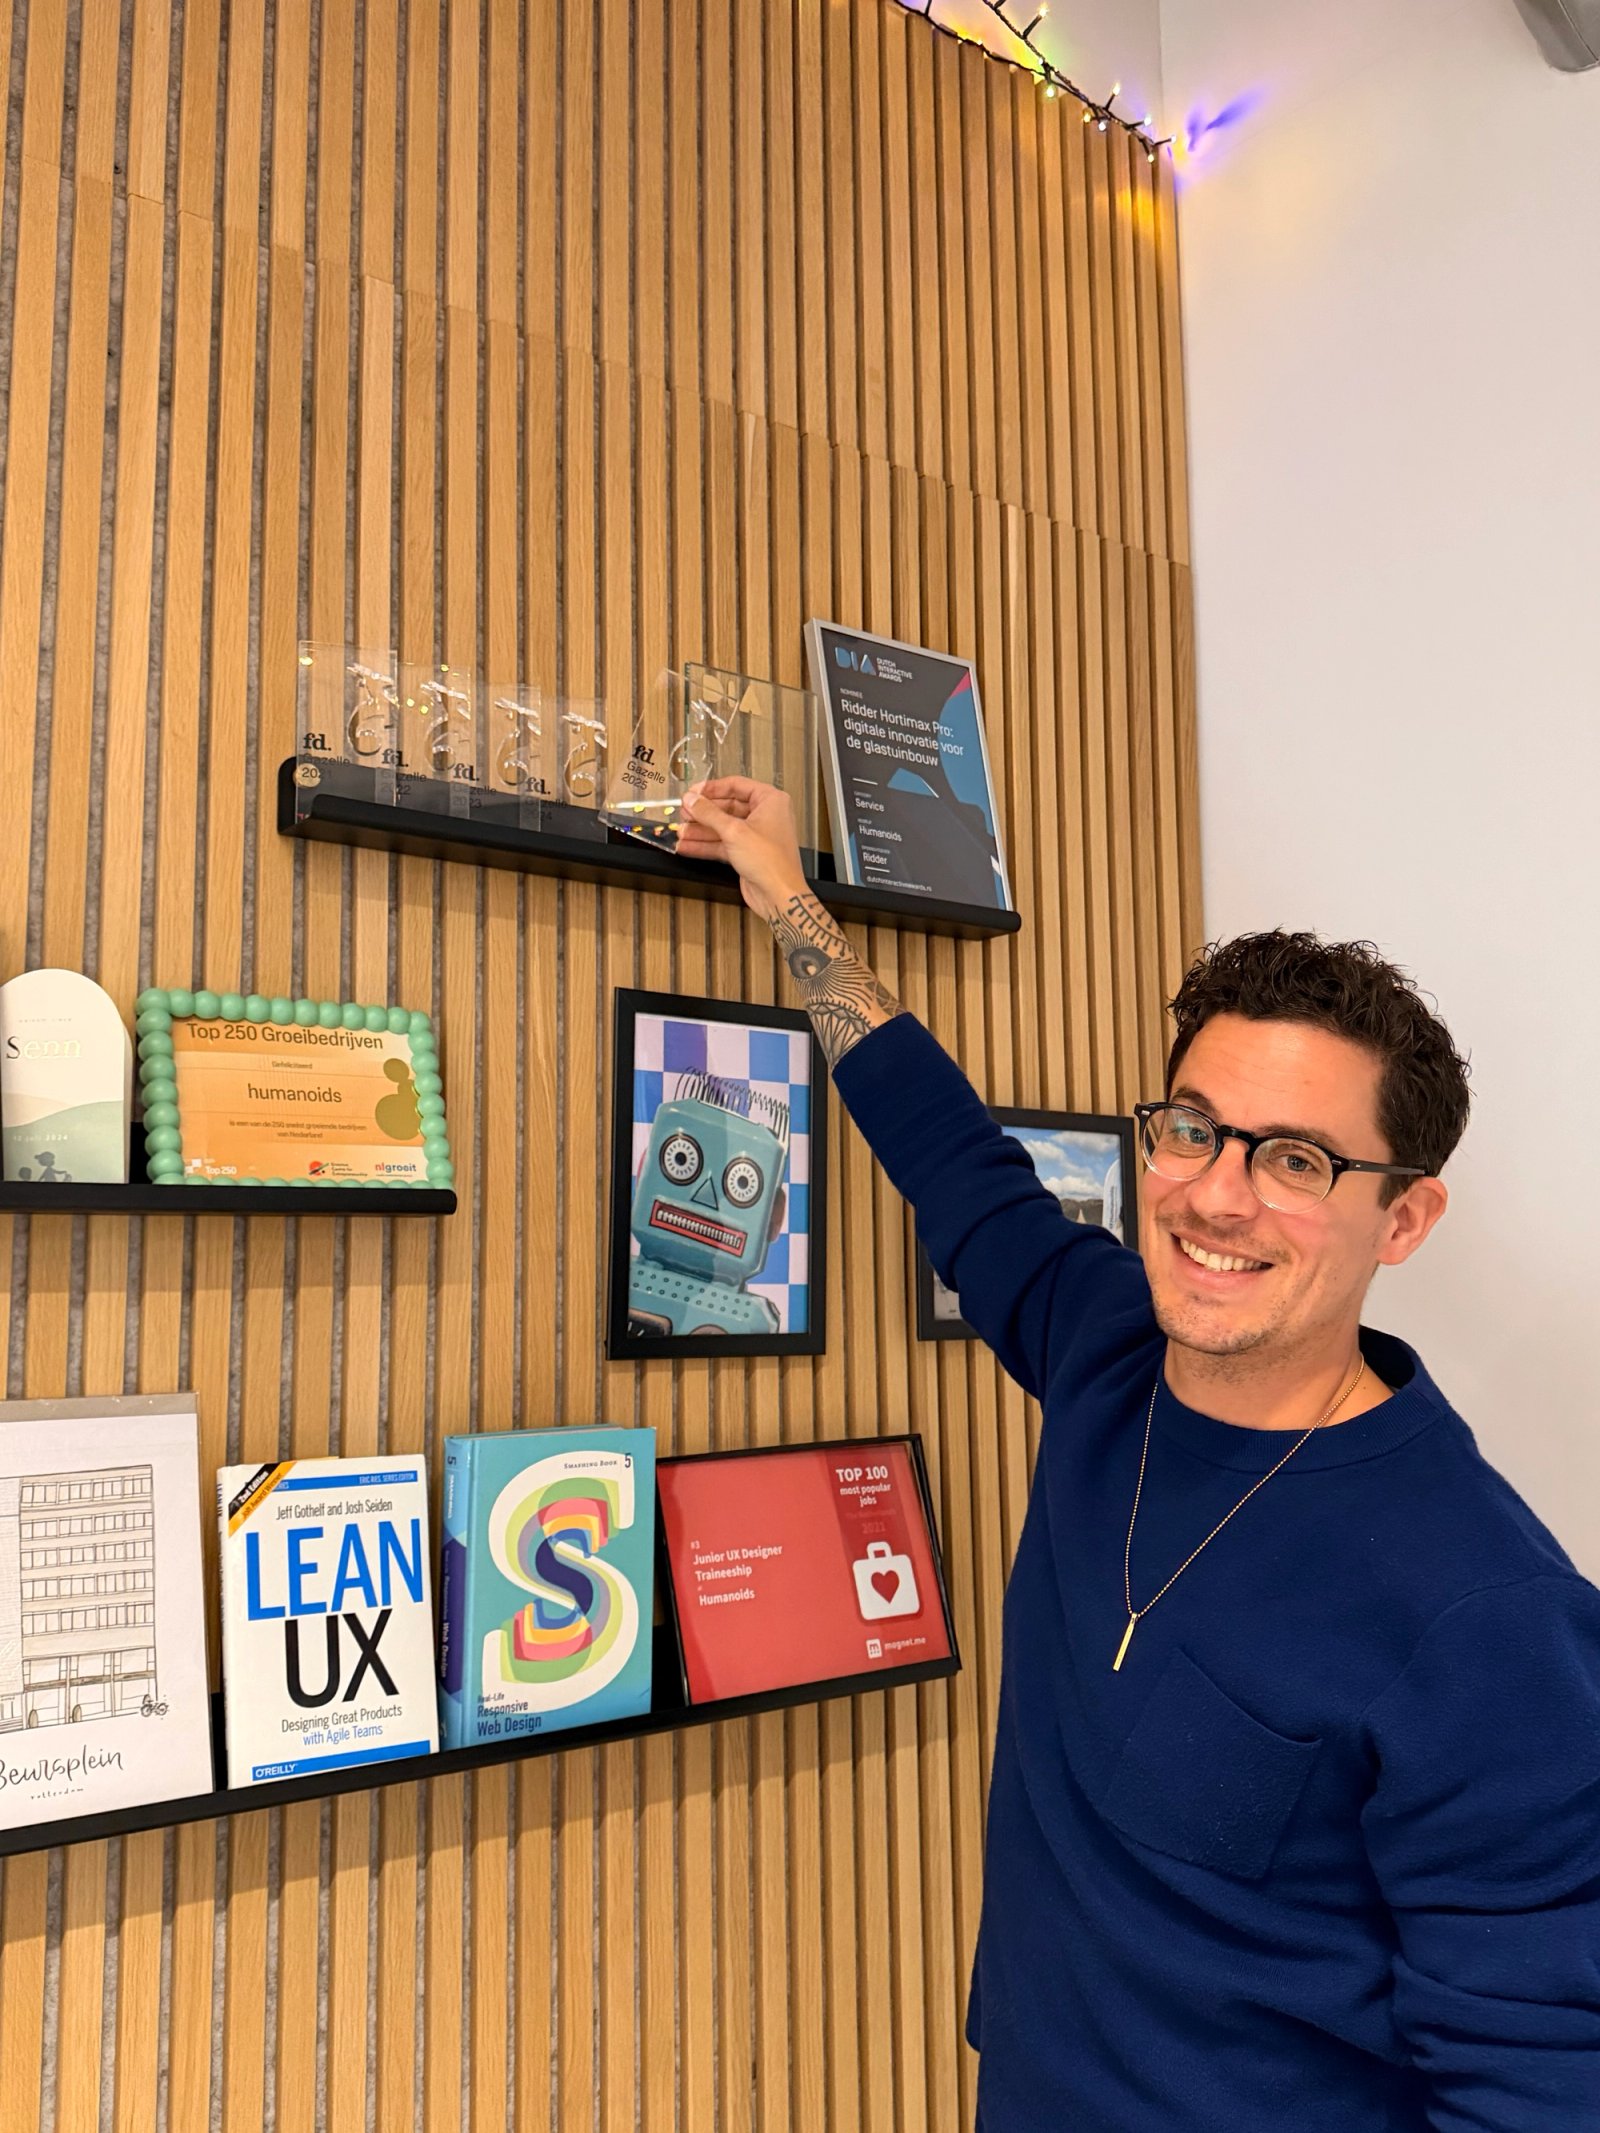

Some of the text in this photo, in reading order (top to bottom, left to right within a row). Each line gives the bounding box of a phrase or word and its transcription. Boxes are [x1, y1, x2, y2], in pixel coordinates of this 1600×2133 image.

[877, 657, 896, 668] DUTCH
[877, 664, 913, 679] INTERACTIVE
[879, 671, 902, 683] AWARDS
[841, 698, 954, 738] Ridder Hortimax Pro:
[303, 732, 332, 751] fd.
[844, 717, 964, 757] digitale innovatie voor
[381, 748, 409, 767] fd.
[632, 745, 655, 766] fd.
[846, 734, 939, 767] de glastuinbouw
[453, 762, 480, 782] fd.
[621, 772, 648, 791] 2025
[626, 760, 666, 784] Gazelle
[526, 777, 551, 795] fd.
[855, 797, 885, 813] Service
[859, 824, 903, 842] Humanoids
[862, 851, 888, 865] Ridder
[187, 1022, 384, 1050] Top 250 Groeibedrijven
[247, 1082, 342, 1103] humanoids
[205, 1166, 220, 1176] Top
[624, 1452, 632, 1469] 5
[249, 1471, 270, 1496] Edition
[835, 1465, 889, 1483] TOP 100
[840, 1482, 892, 1496] most popular
[276, 1498, 393, 1521] Jeff Gothelf and Josh Seiden
[859, 1495, 877, 1508] jobs
[690, 1540, 701, 1550] #3
[693, 1545, 783, 1566] Junior UX Designer
[246, 1518, 424, 1621] LEAN
[695, 1564, 753, 1582] Traineeship
[699, 1587, 755, 1606] Humanoids
[442, 1621, 450, 1643] Web
[884, 1637, 926, 1650] magnet.me
[284, 1608, 400, 1709] UX
[441, 1644, 449, 1678] Design
[281, 1704, 403, 1733] Designing Great Products
[477, 1699, 529, 1719] Responsive
[303, 1723, 383, 1746] with Agile Teams
[477, 1714, 542, 1737] Web Design
[30, 1788, 84, 1800] rotterdam
